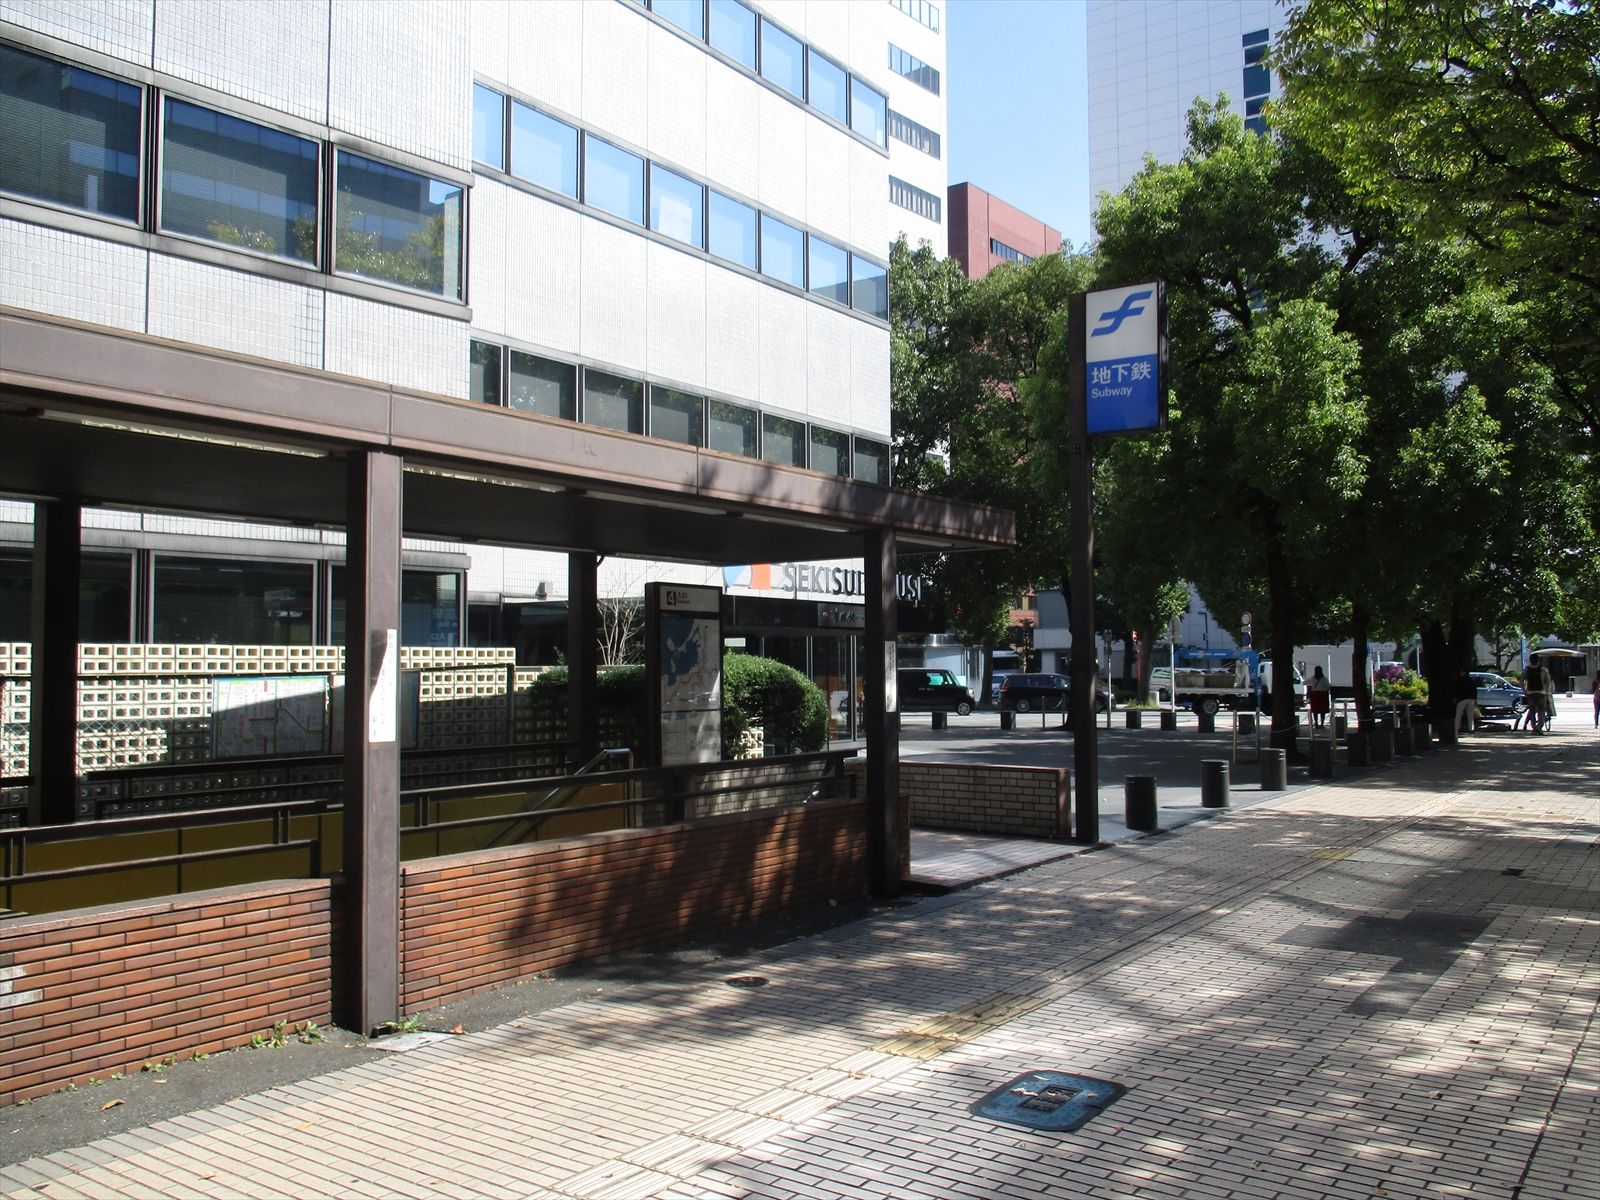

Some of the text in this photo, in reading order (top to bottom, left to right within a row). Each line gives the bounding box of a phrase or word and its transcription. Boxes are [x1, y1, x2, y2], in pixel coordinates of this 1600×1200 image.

[1091, 361, 1151, 384] 地下鉄
[1091, 387, 1132, 398] Subway
[668, 591, 676, 605] 4
